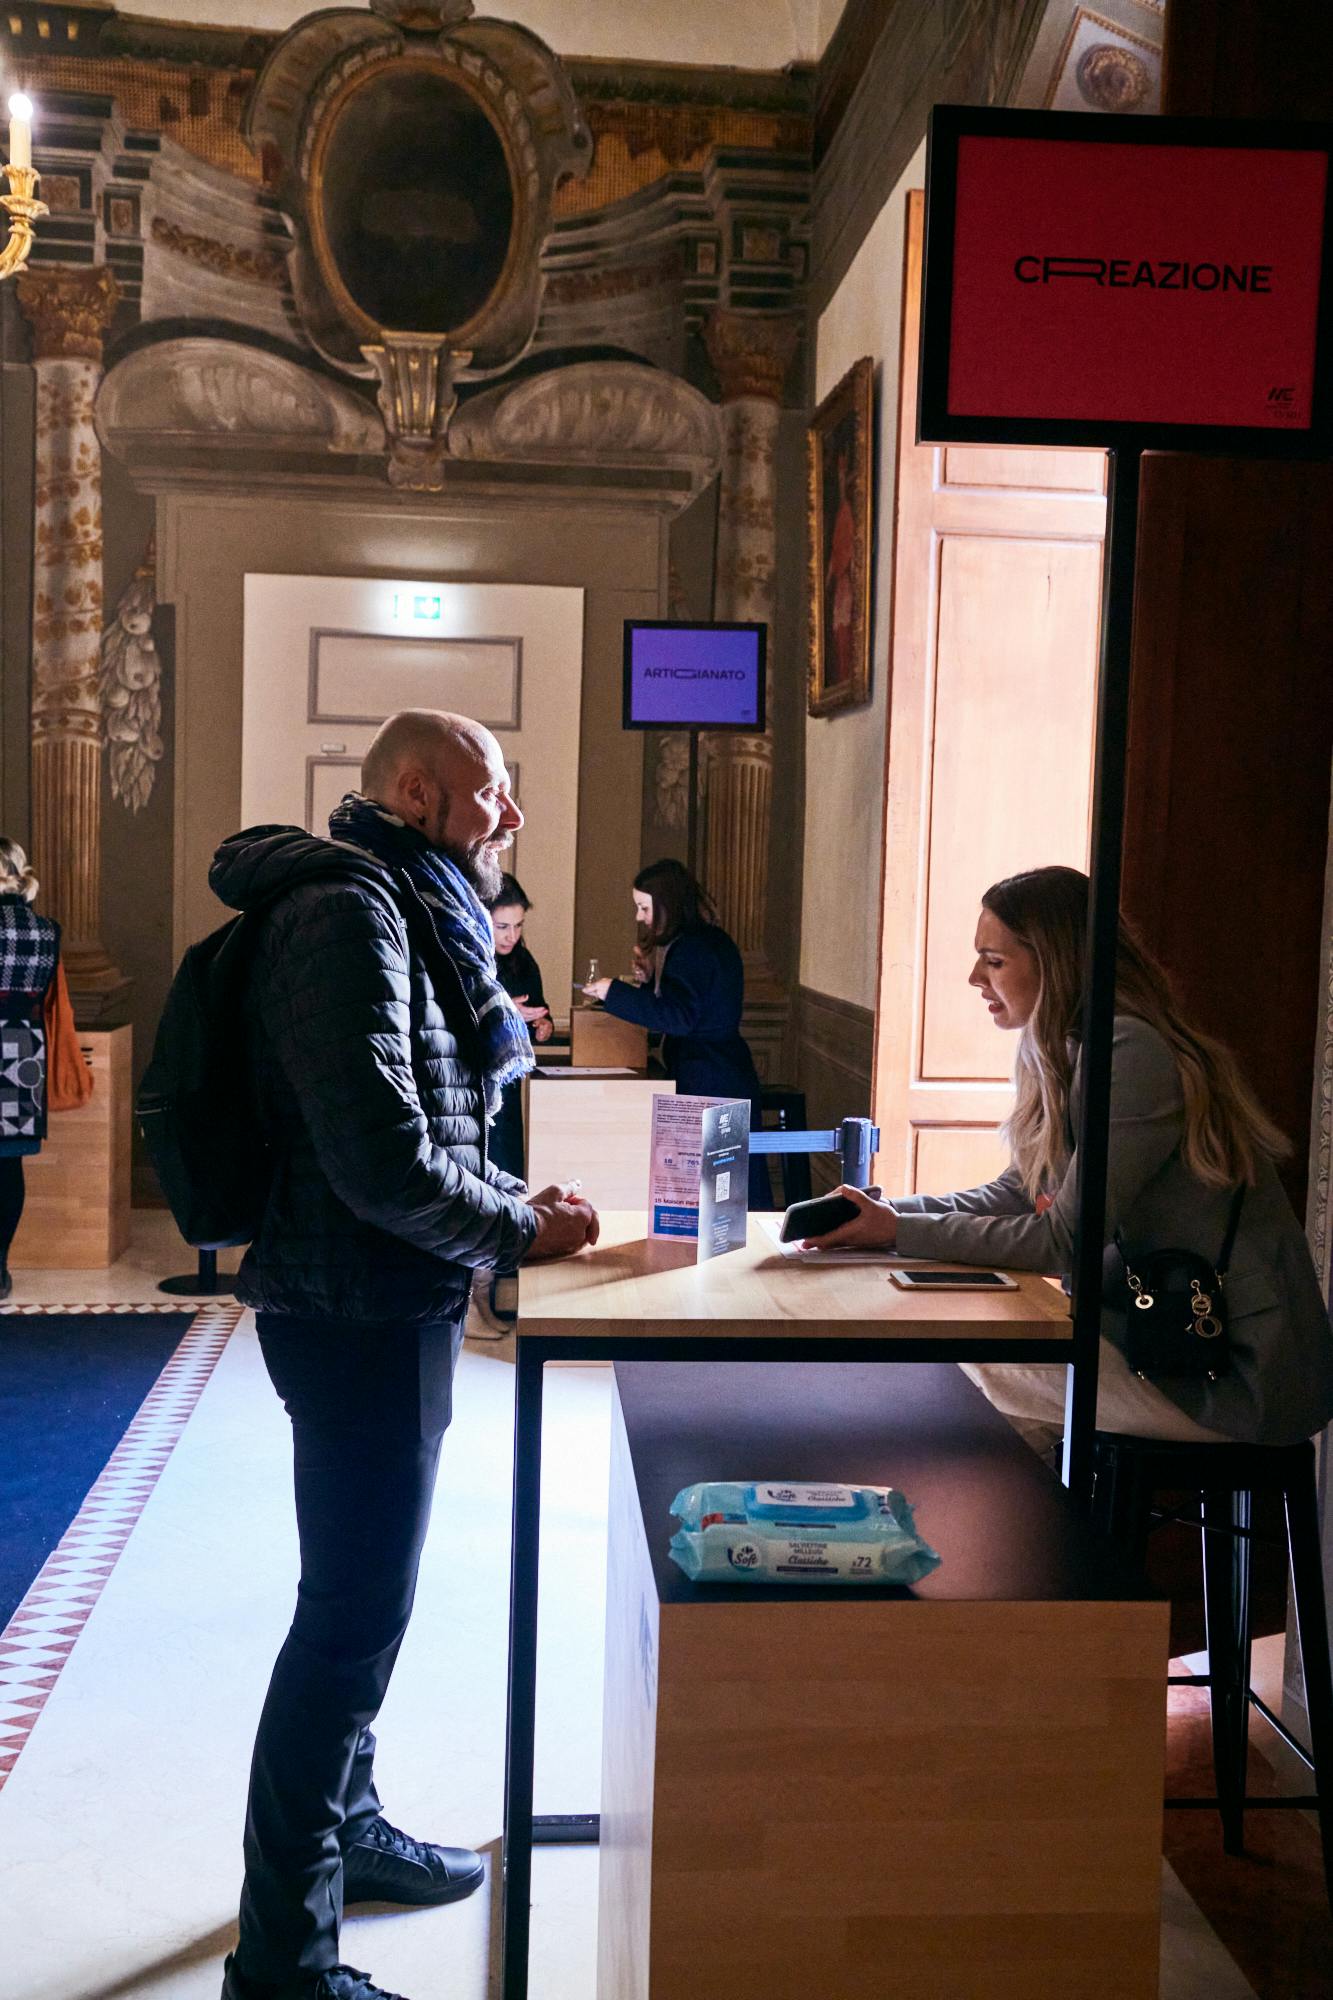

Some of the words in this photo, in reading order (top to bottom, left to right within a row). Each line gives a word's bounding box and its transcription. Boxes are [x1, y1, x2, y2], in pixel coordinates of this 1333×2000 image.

[1014, 256, 1273, 294] CREAZIONE
[643, 667, 746, 681] ARTIGIANATO
[734, 1552, 759, 1568] Soft
